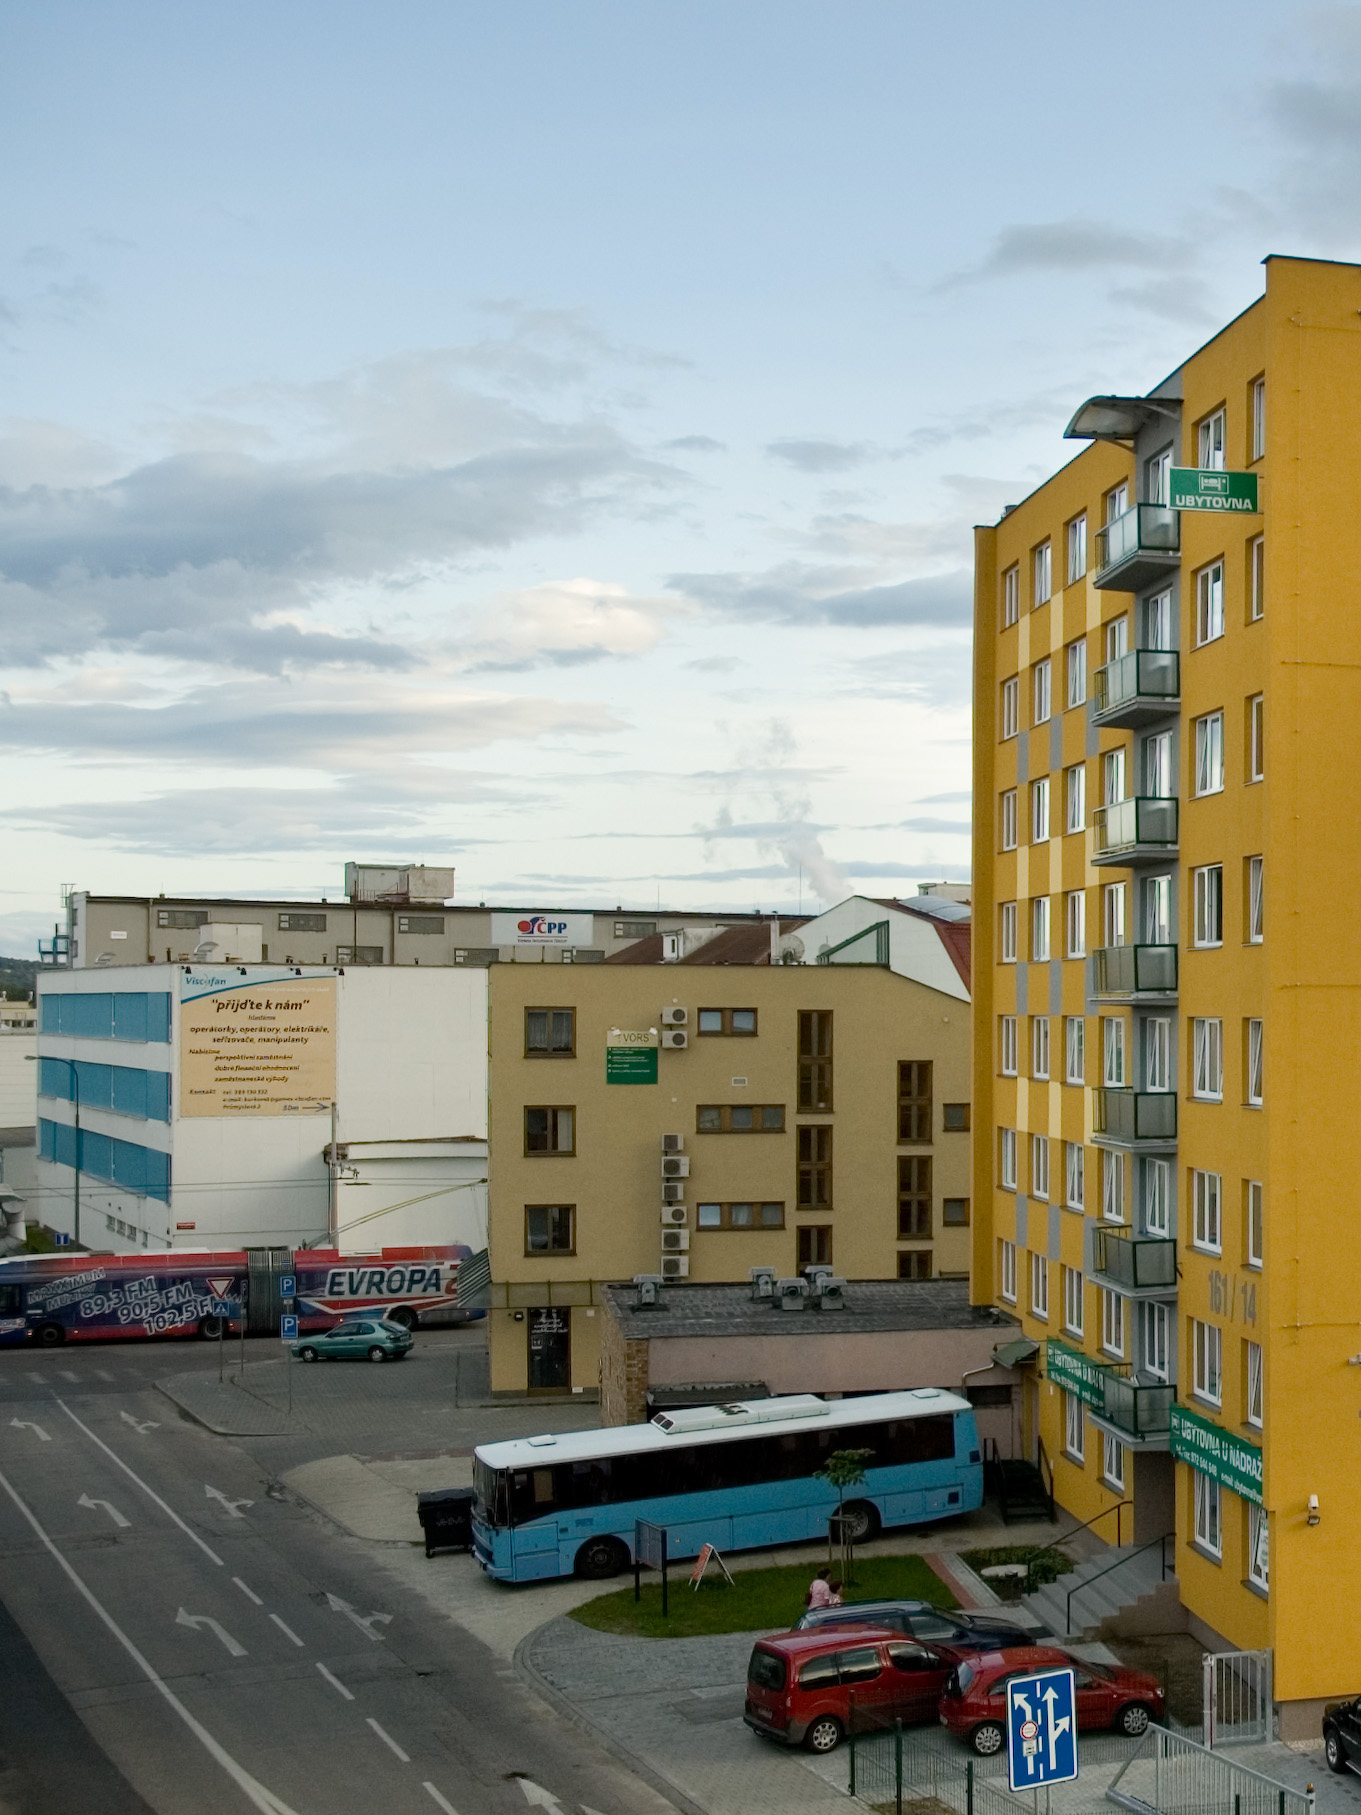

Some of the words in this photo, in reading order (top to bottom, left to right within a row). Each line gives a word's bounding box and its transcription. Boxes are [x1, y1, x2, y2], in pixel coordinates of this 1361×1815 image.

[1175, 494, 1253, 510] UBYTOVNA
[265, 999, 273, 1010] k
[622, 1033, 650, 1043] VORS
[81, 1289, 124, 1317] 89,3
[125, 1275, 158, 1302] FM
[328, 1267, 441, 1296] EVROPA
[118, 1293, 161, 1324] 90,5
[162, 1281, 194, 1309] FM
[1208, 1269, 1227, 1316] 161
[1241, 1280, 1257, 1328] 14
[143, 1302, 197, 1336] 102,5
[284, 1318, 294, 1331] P
[1181, 1418, 1221, 1459] UBYTOVNA
[1222, 1440, 1228, 1462] U
[1229, 1444, 1263, 1483] NÁDRAŽ
